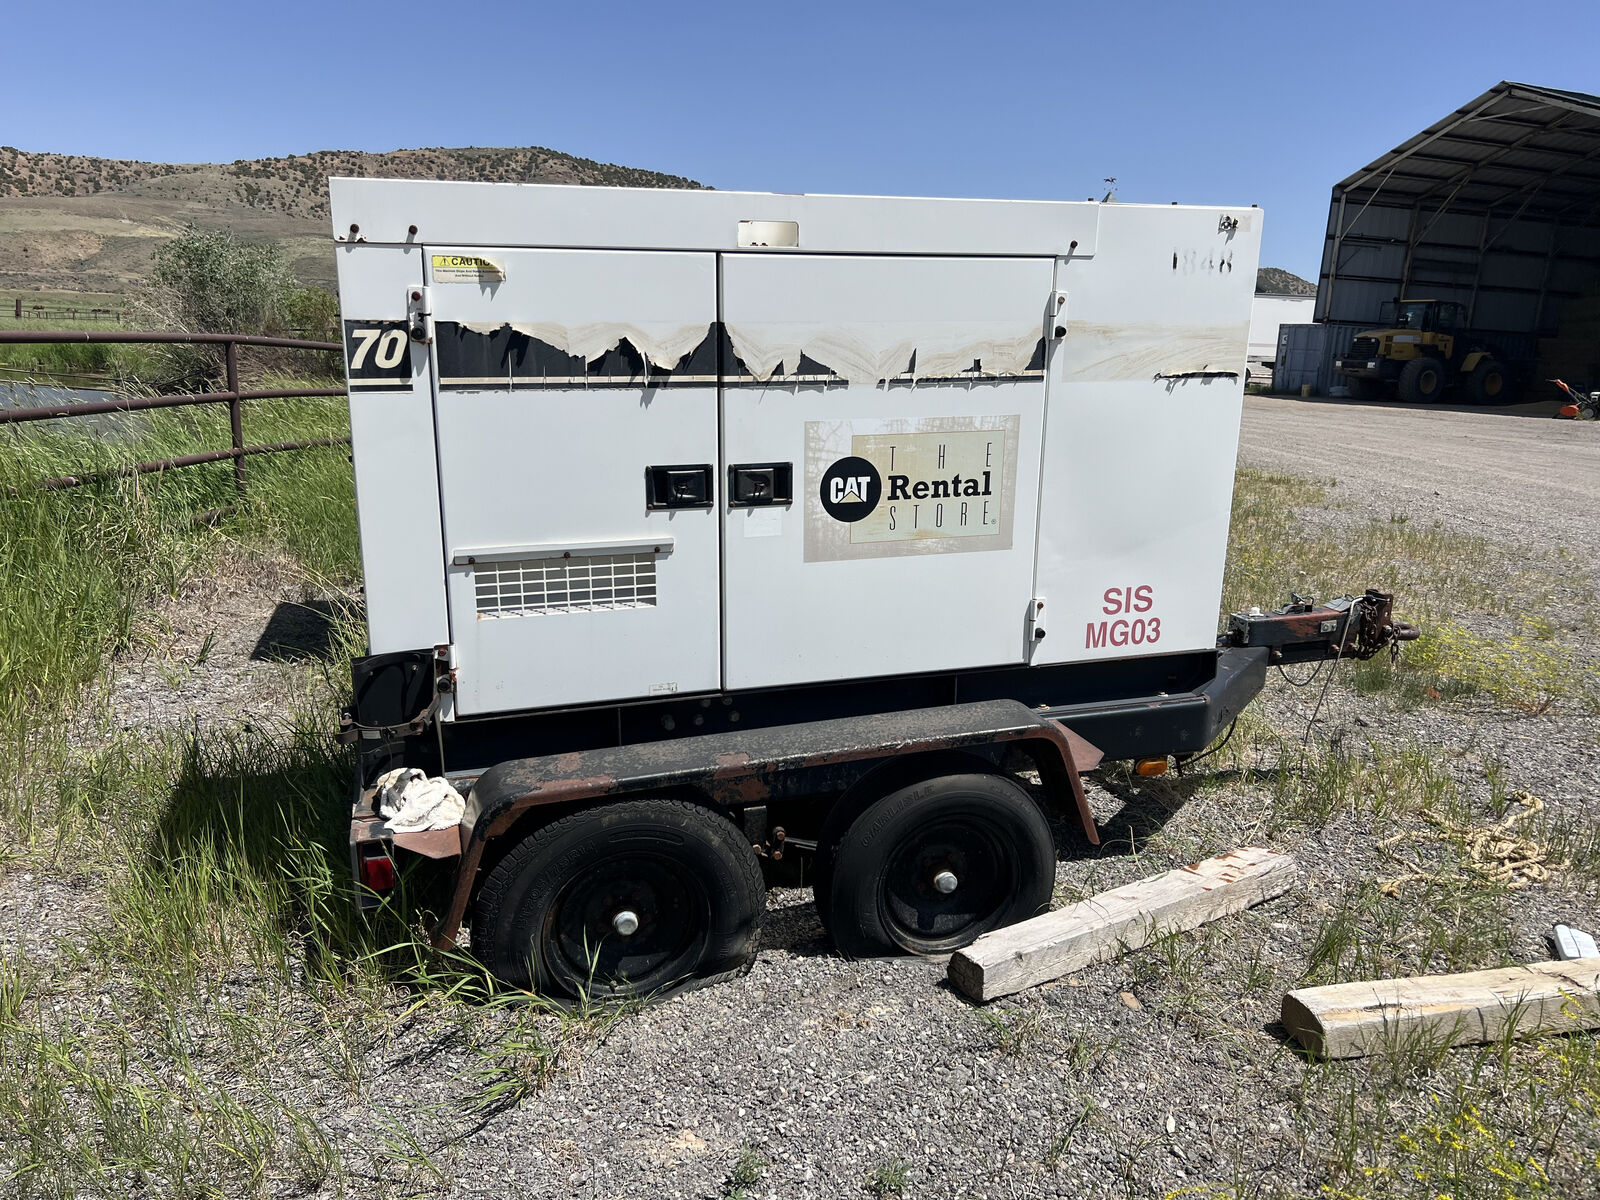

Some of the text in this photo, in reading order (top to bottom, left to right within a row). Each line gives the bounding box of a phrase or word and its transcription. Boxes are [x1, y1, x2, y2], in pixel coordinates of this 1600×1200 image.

[451, 257, 493, 266] CAUTIO
[350, 328, 408, 370] 70
[889, 442, 992, 471] THE
[829, 476, 871, 504] CAT
[887, 471, 992, 500] Rental
[1102, 584, 1154, 615] SIS
[1085, 617, 1161, 649] MG03
